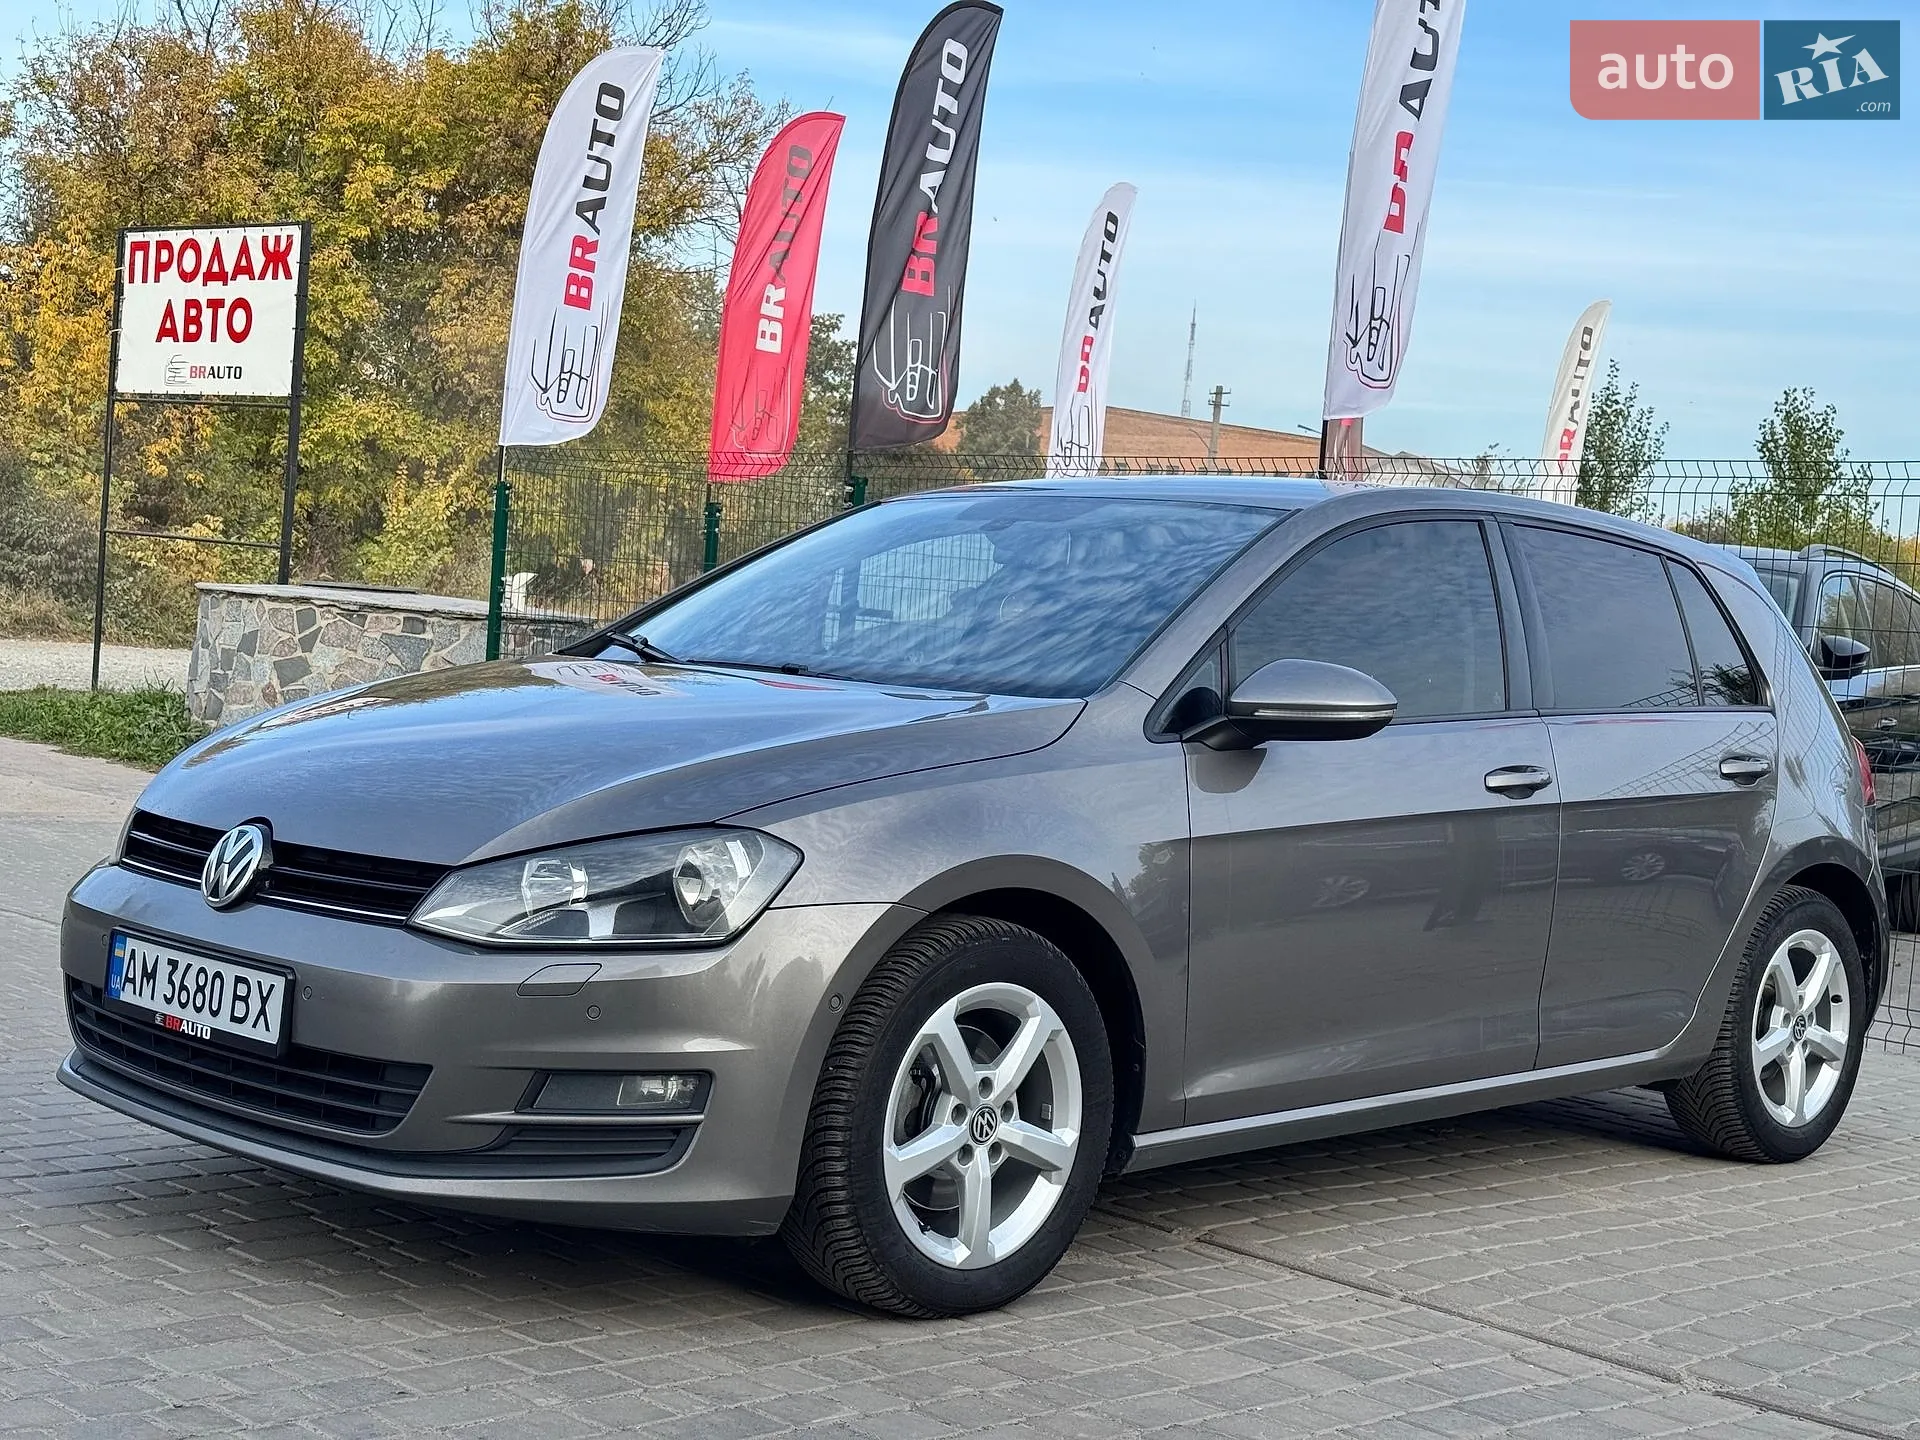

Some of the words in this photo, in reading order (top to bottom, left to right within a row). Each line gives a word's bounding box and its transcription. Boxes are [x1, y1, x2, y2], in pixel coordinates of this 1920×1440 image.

[901, 37, 968, 297] BRAUTO
[563, 81, 626, 311] BRAUTO
[128, 235, 294, 287] ПРОДАЖ
[755, 144, 813, 354] BRAUTO
[155, 297, 253, 343] АВТО
[189, 365, 243, 380] BRAUTO
[110, 975, 121, 990] UA
[122, 948, 160, 1001] AM
[163, 957, 225, 1018] 3680
[229, 974, 276, 1033] BX
[165, 1014, 211, 1040] BRAUTO
